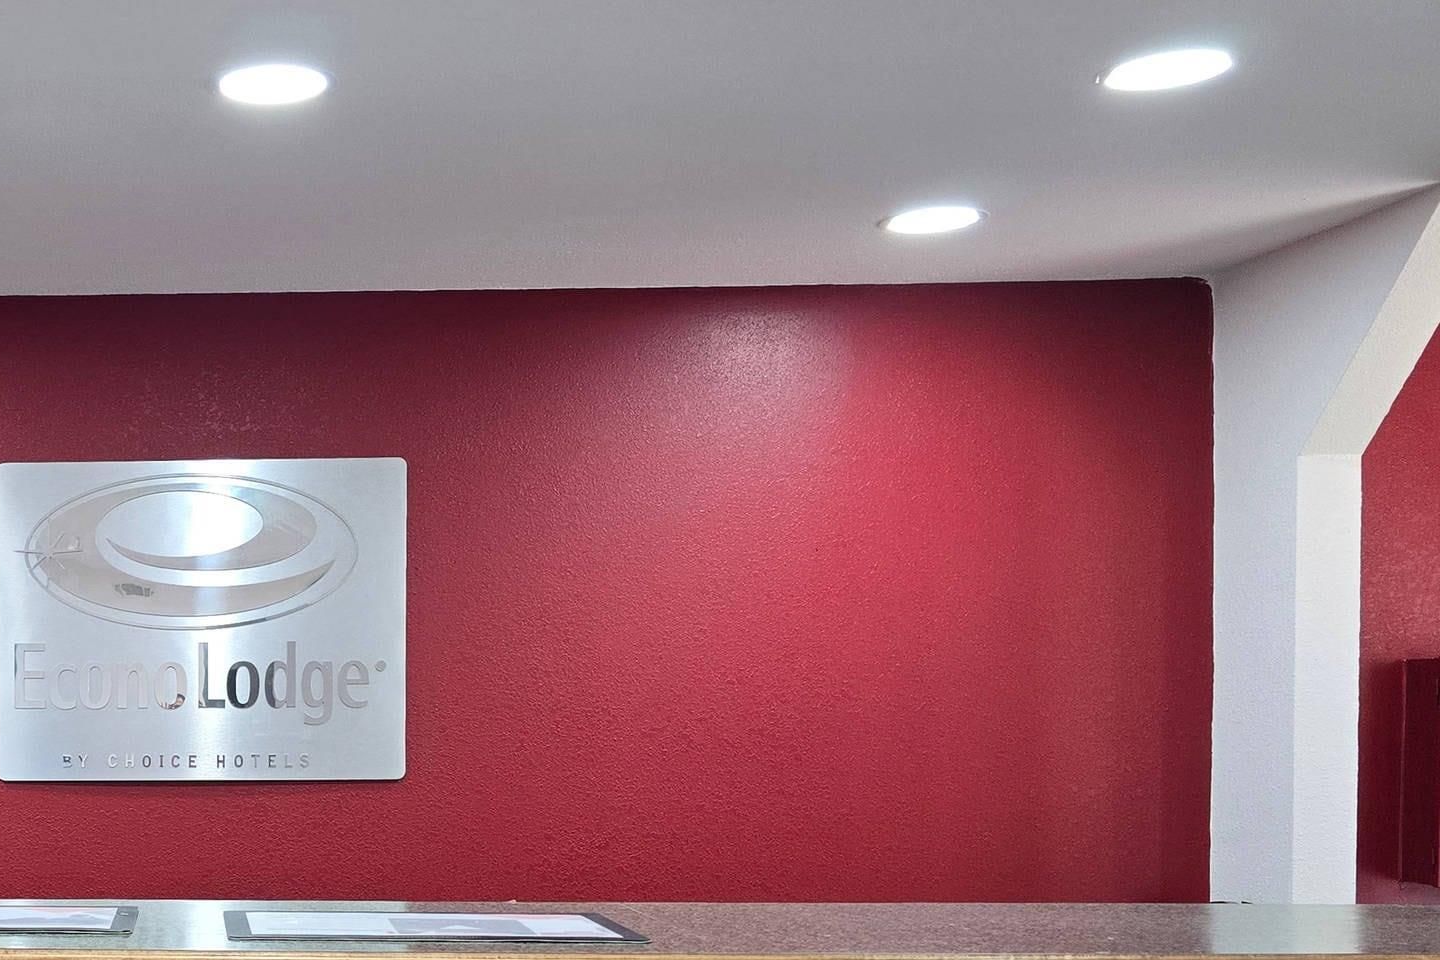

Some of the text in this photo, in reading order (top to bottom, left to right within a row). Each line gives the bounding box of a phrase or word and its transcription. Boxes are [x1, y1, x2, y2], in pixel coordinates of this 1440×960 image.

[63, 754, 310, 769] BY CHOICE HOTELS
